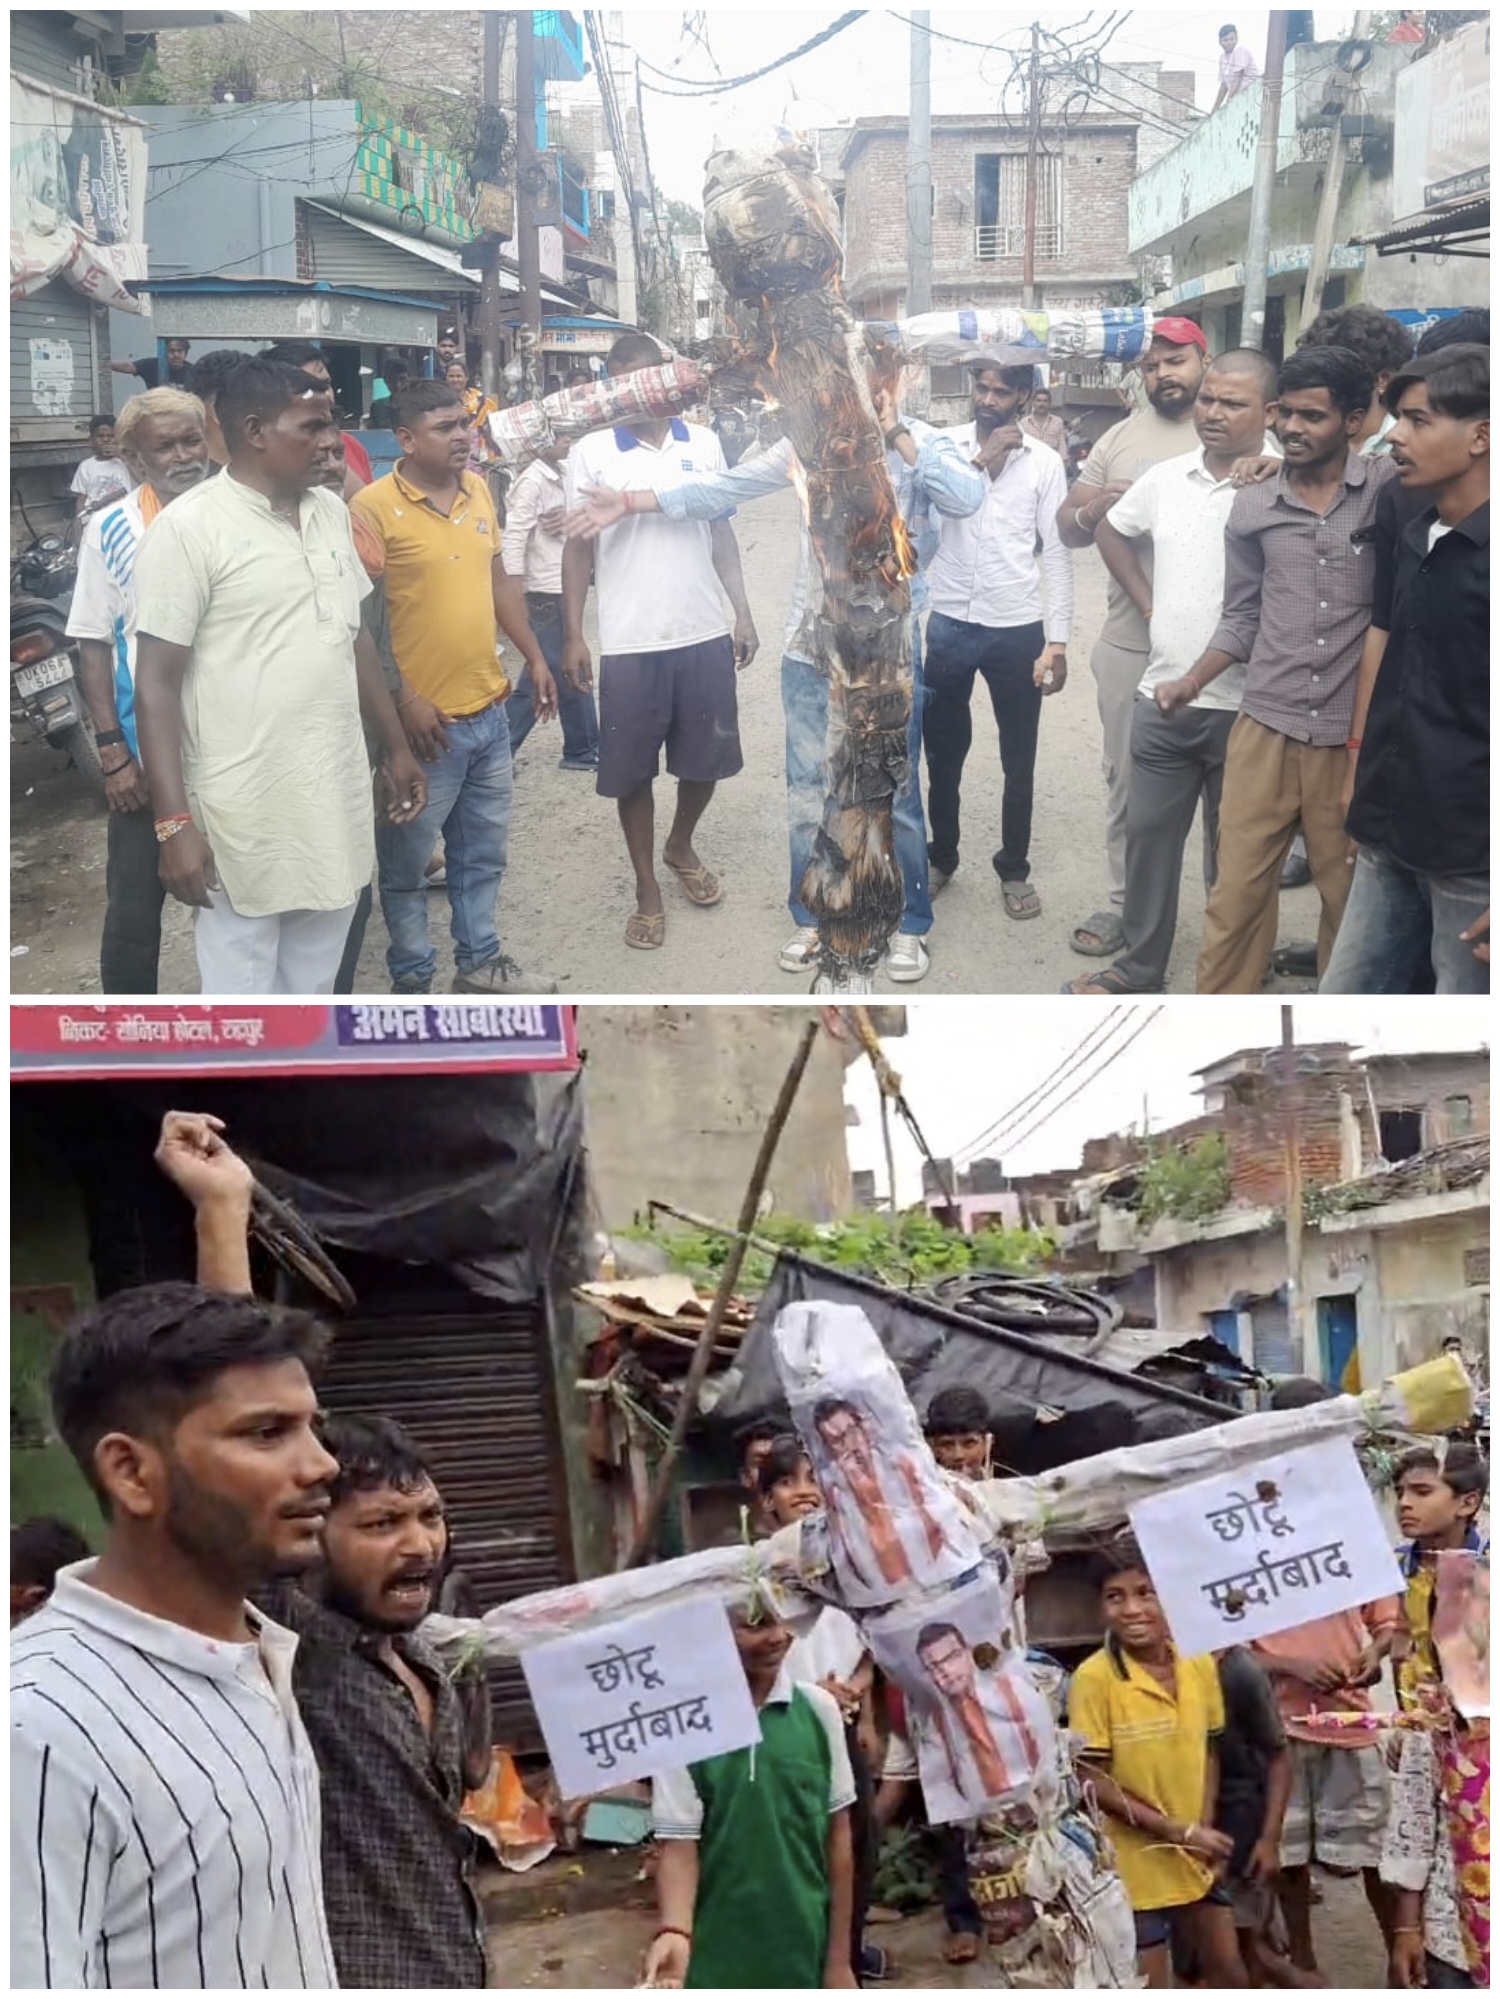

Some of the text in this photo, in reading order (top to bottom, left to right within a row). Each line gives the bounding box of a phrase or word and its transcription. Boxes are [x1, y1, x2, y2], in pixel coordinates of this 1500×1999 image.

[1201, 1542, 1353, 1622] मुर्दाबाद
[585, 1643, 665, 1692] छोटू
[579, 1696, 713, 1769] मुर्दाबाद
